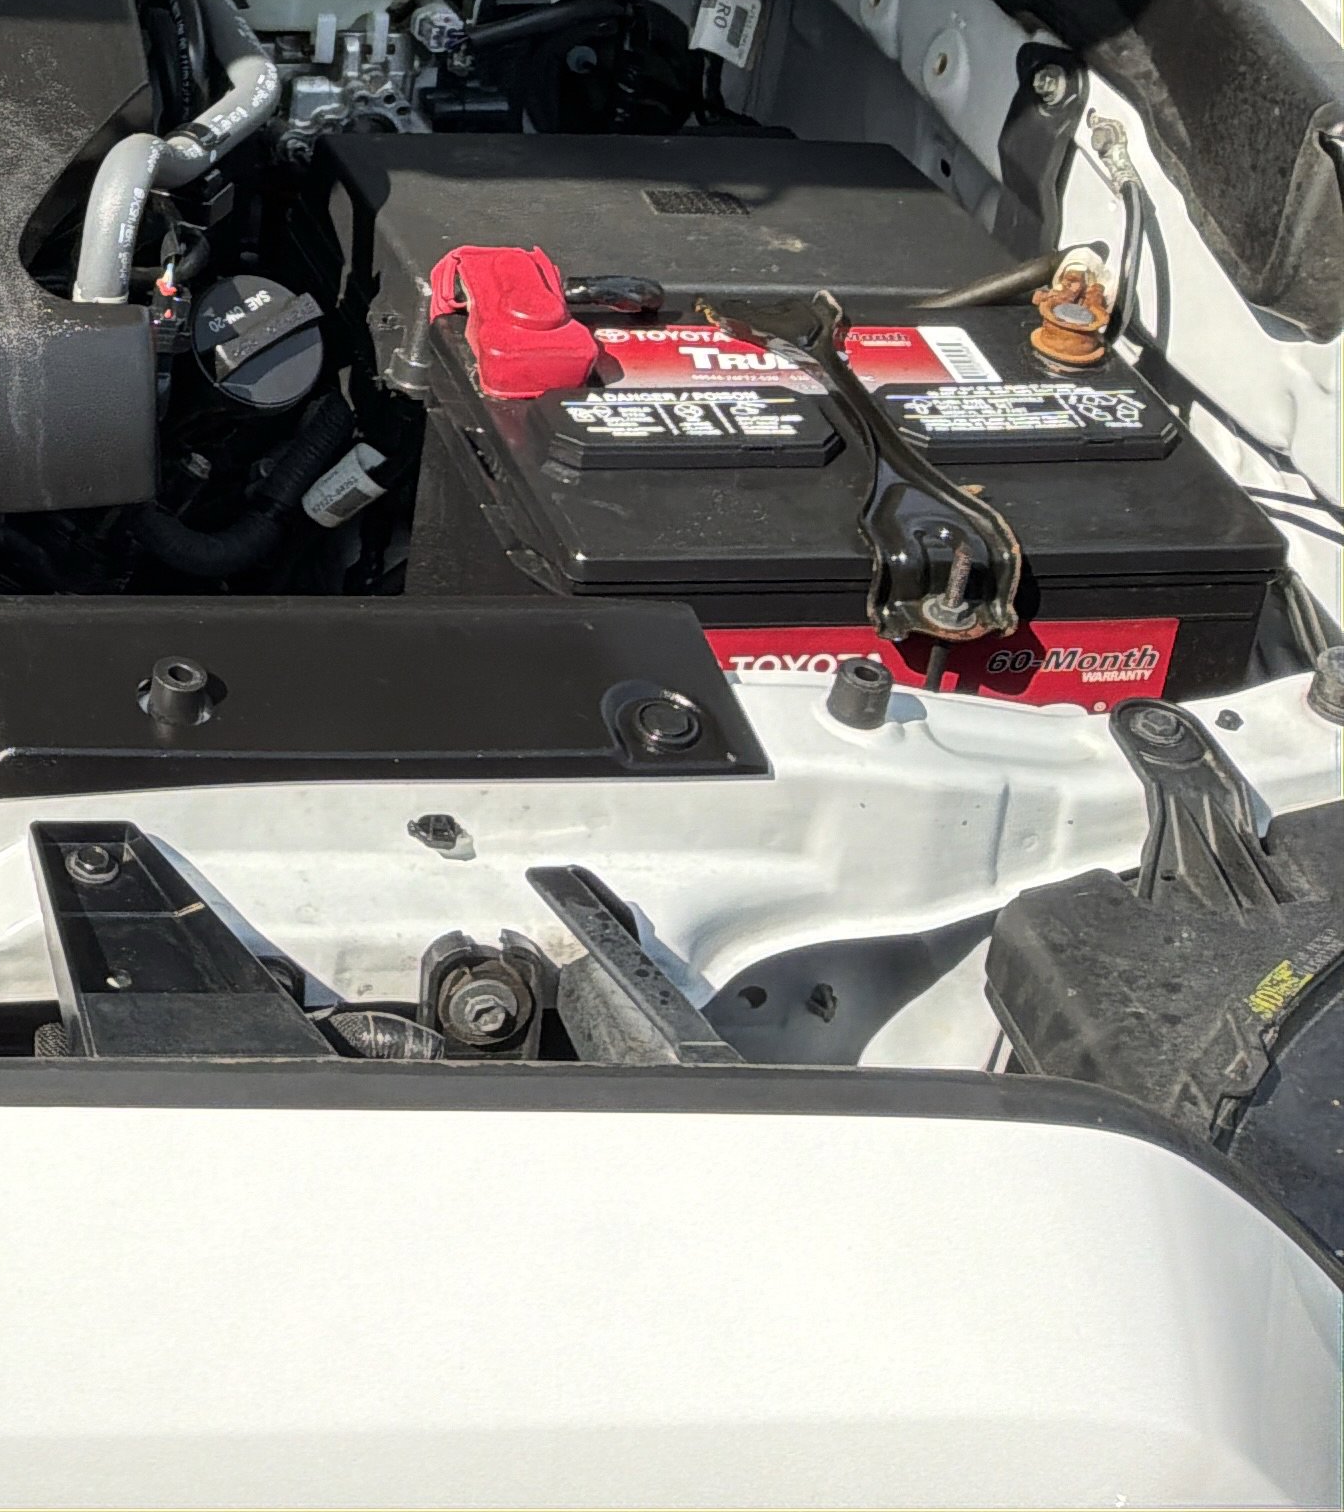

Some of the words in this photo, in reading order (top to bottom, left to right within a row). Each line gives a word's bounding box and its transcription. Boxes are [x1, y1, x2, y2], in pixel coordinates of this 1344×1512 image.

[243, 289, 272, 312] SAE
[629, 329, 734, 343] TOYOTA
[603, 391, 677, 402] DANGER
[691, 390, 760, 401] POISON
[729, 653, 883, 674] TOYO
[987, 645, 1160, 674] 60-Month
[1082, 669, 1153, 683] WARRANTY
